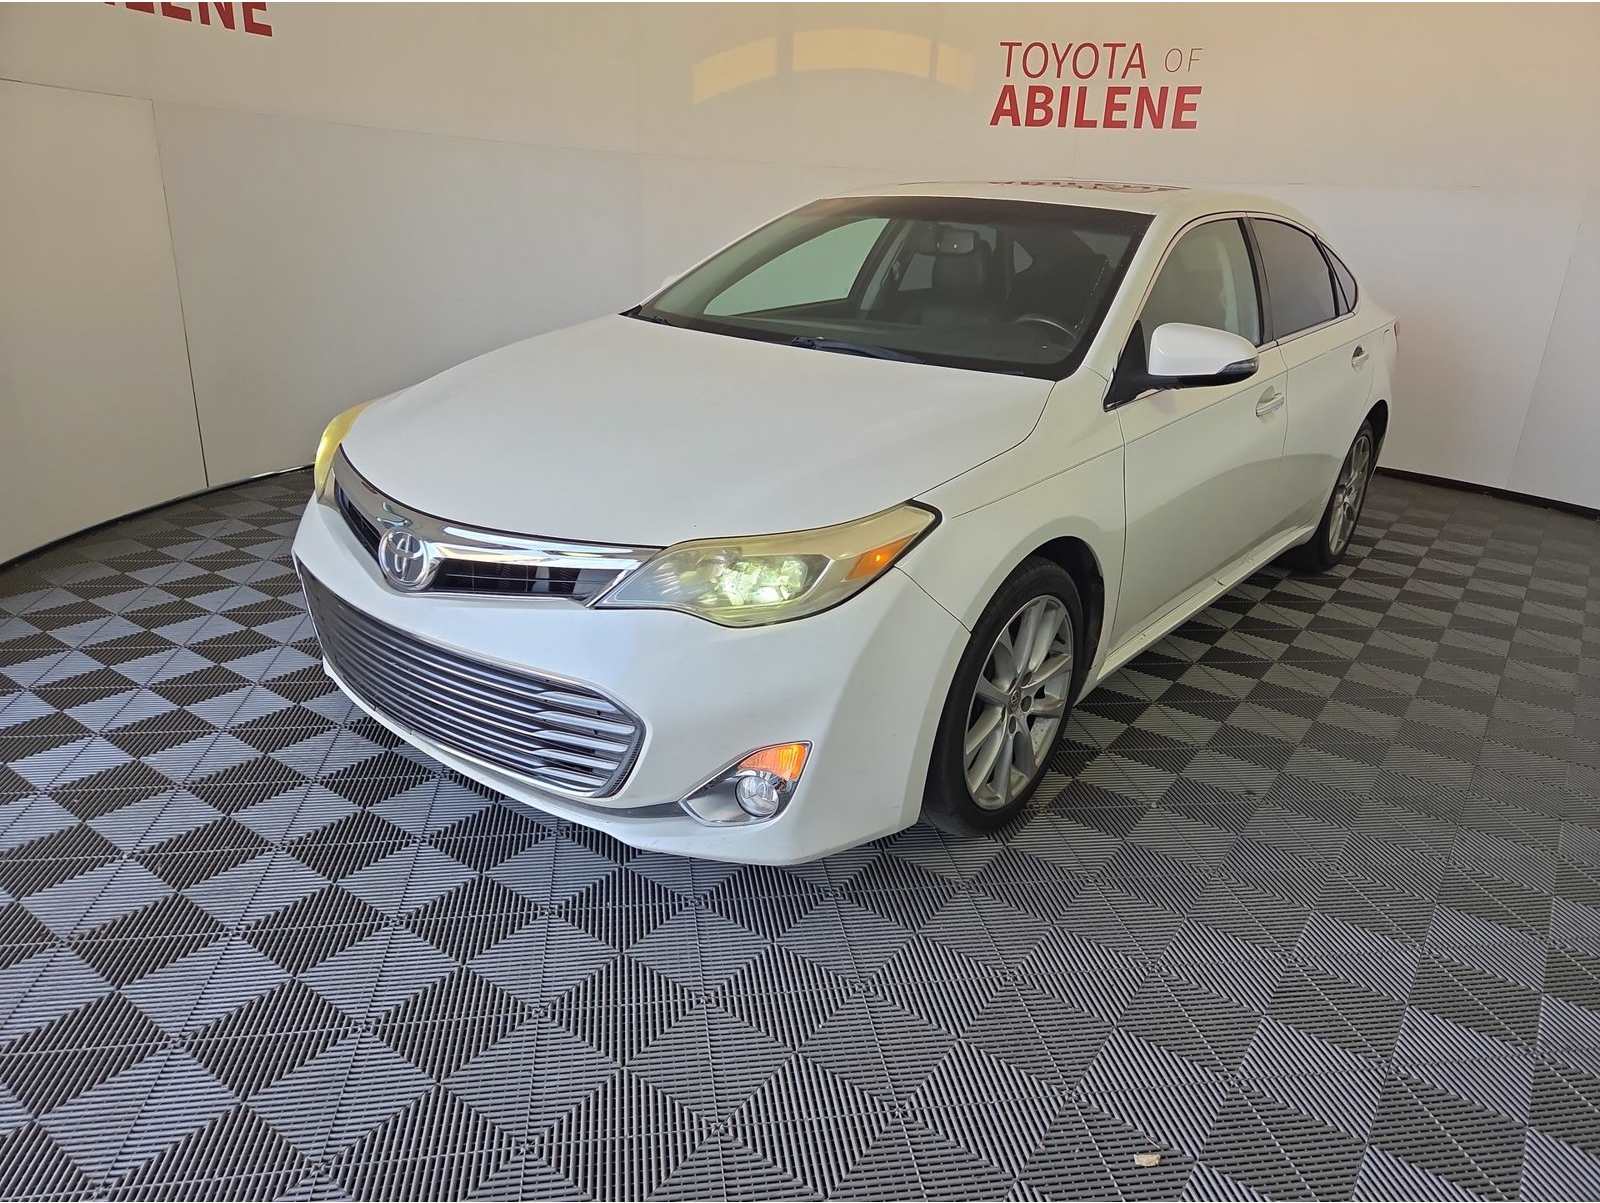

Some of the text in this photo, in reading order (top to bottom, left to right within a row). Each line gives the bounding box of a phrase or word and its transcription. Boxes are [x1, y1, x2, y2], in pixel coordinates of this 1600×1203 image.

[1000, 42, 1203, 79] TOYOTA OF
[989, 85, 1202, 129] ABILENE
